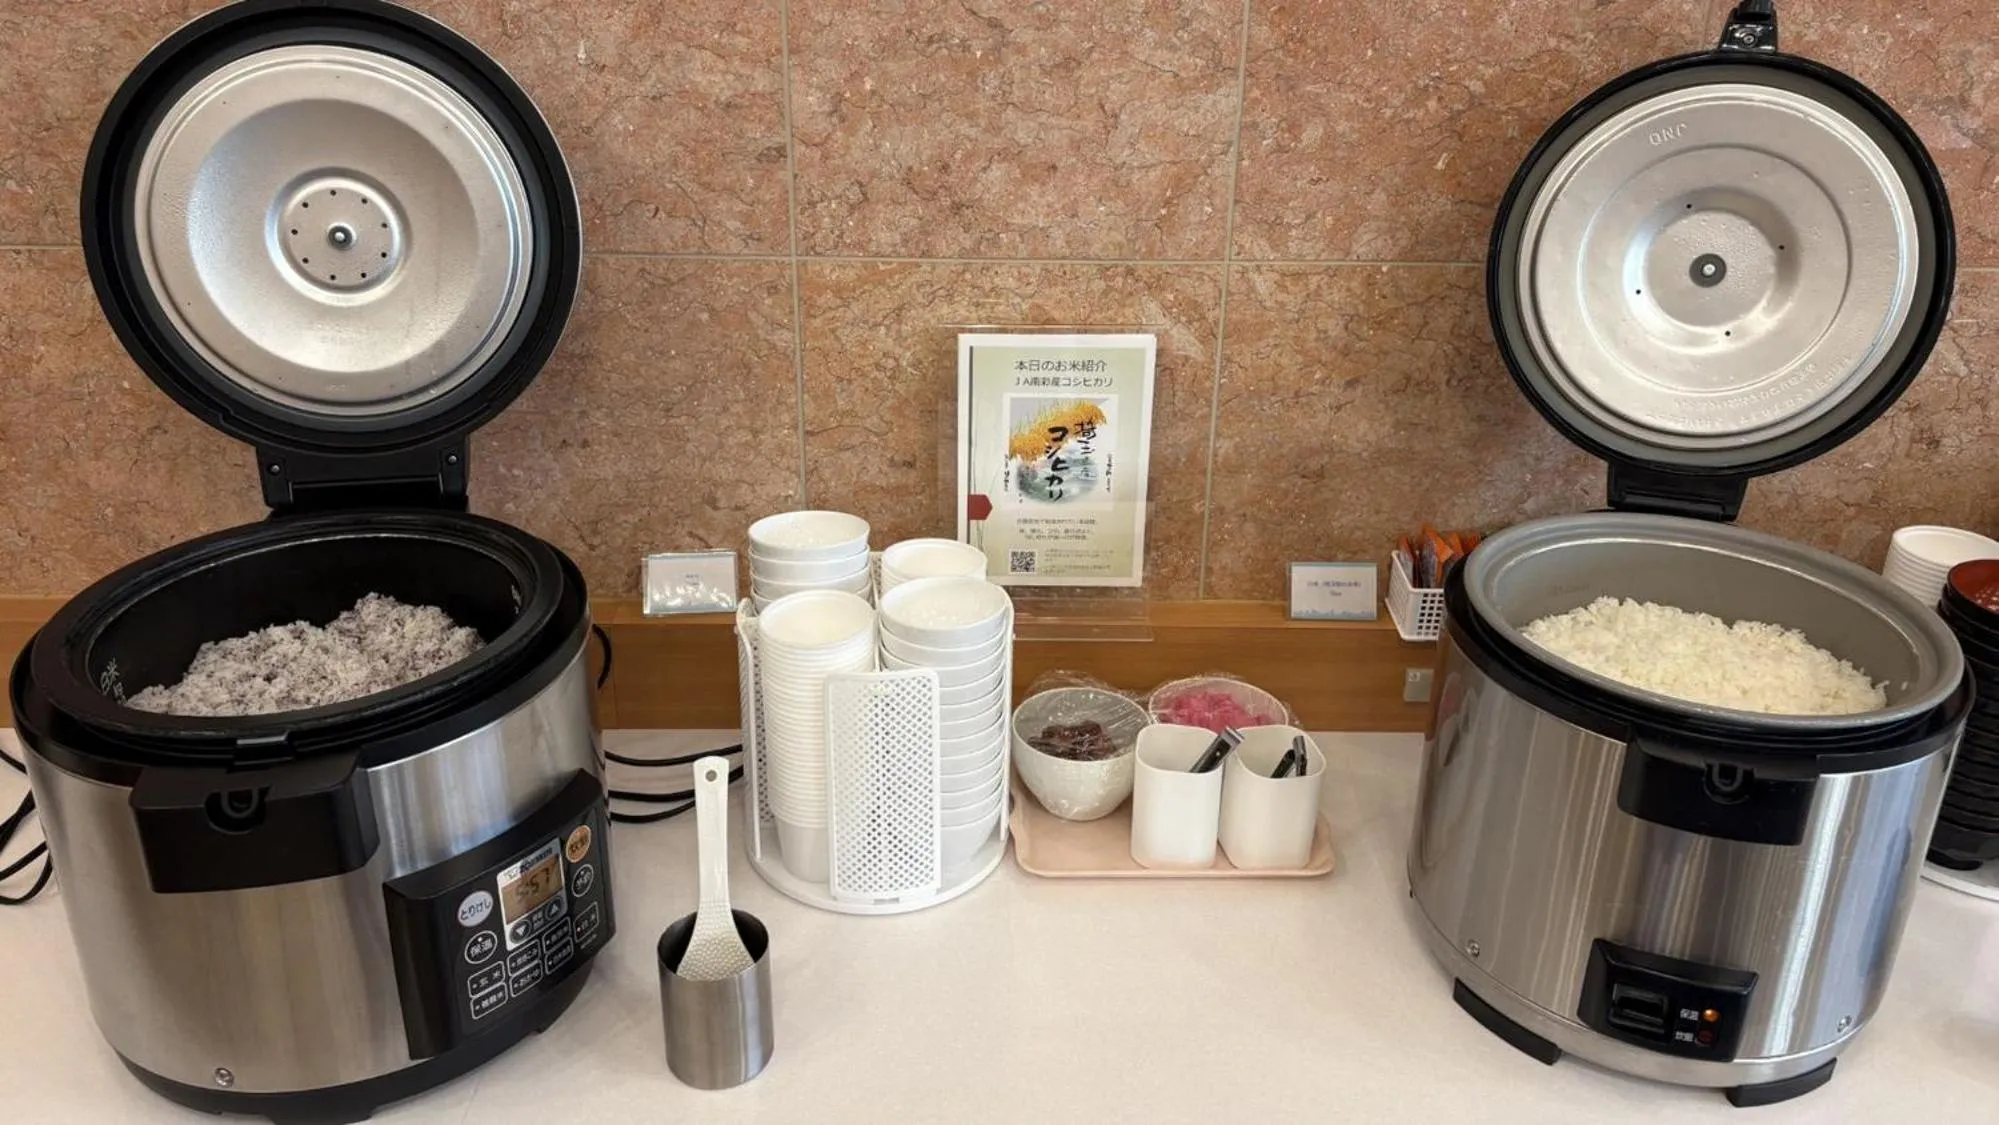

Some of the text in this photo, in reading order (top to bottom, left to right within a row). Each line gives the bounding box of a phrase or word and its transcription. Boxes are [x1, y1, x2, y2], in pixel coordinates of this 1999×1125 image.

[1014, 360, 1107, 372] 本日のお米紹介
[1044, 426, 1070, 502] コシヒカリ
[460, 898, 492, 921] とりけし
[470, 938, 494, 958] 保温
